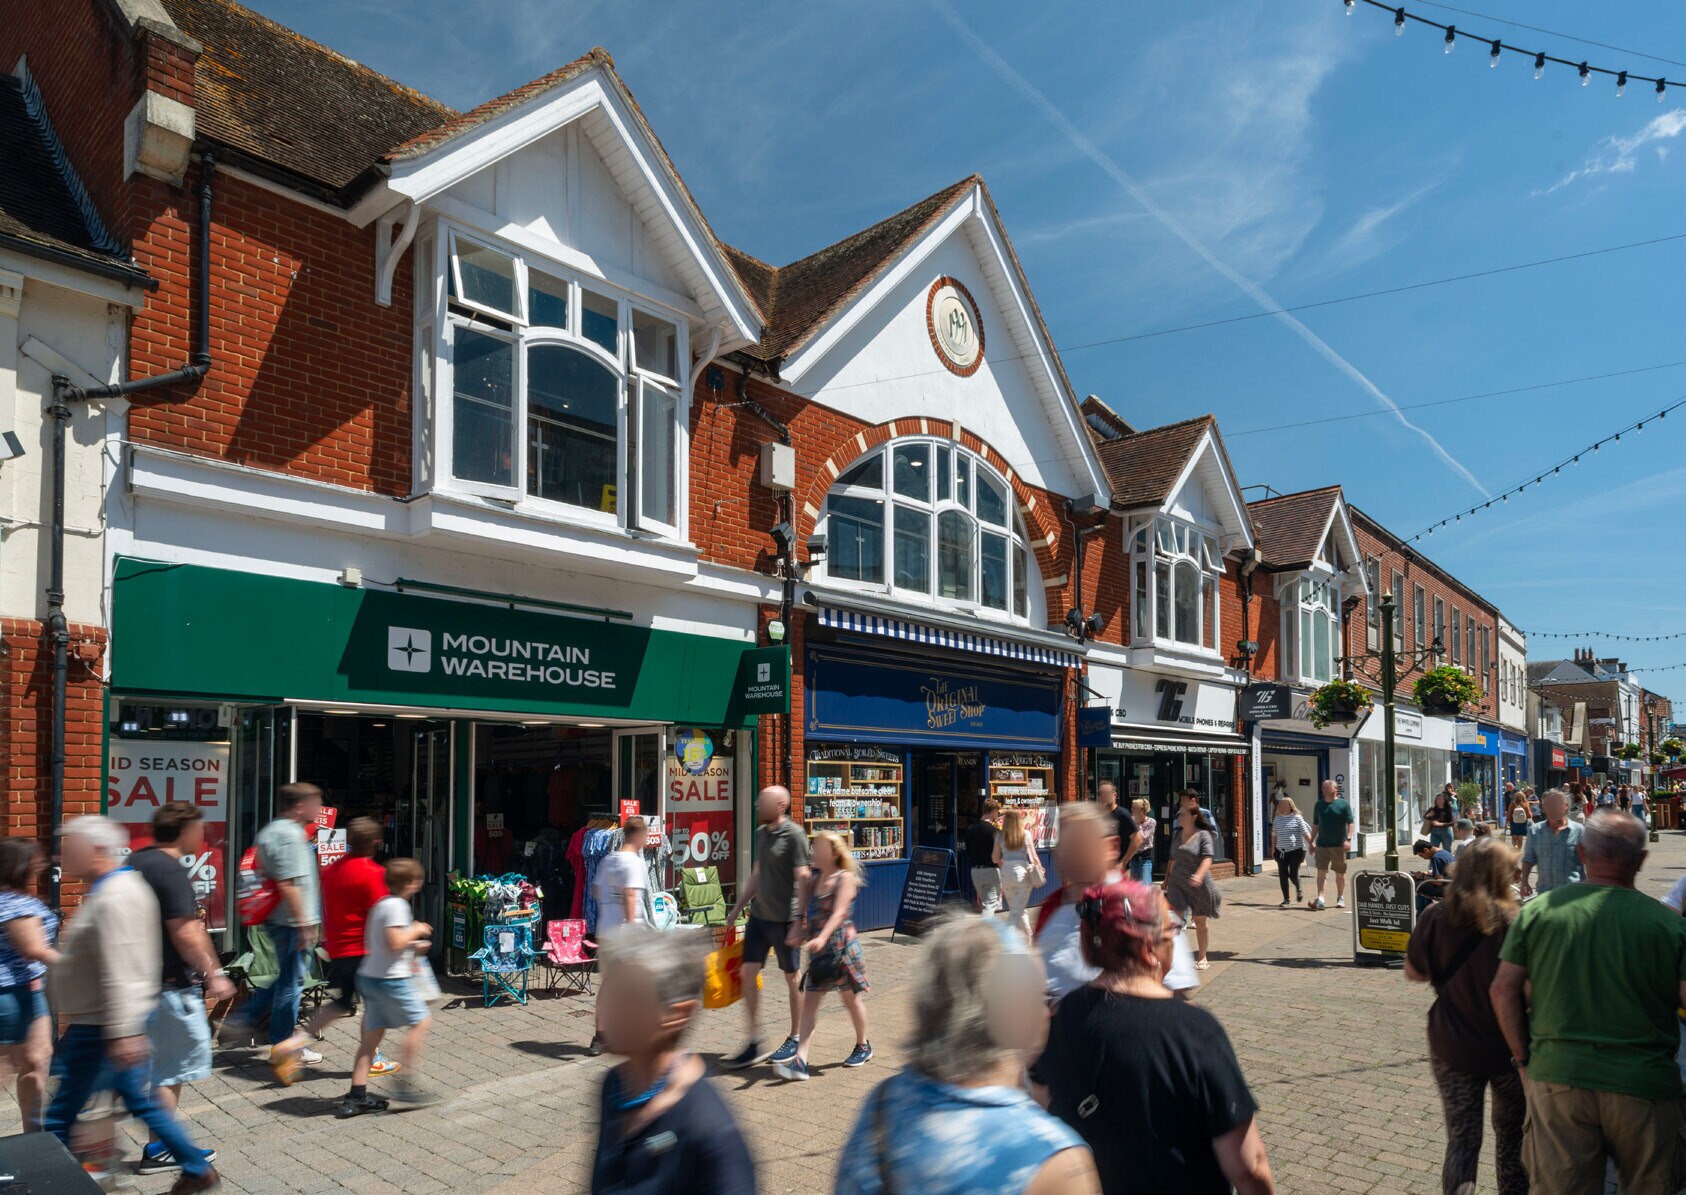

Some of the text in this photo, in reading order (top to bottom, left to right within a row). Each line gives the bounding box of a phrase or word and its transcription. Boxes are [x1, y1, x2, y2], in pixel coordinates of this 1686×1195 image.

[443, 632, 590, 664] MOUNTAIN
[440, 656, 616, 689] WAREHOUSE
[747, 684, 780, 693] MOUNTAIN
[745, 690, 784, 699] WAREHOUSE
[1179, 716, 1195, 725] MOBILE
[1196, 718, 1213, 727] PHONES
[1218, 720, 1235, 729] REPAIRS
[140, 757, 219, 772] SEASON
[669, 767, 687, 776] MID
[670, 780, 729, 802] SALE
[320, 843, 346, 852] SALE
[711, 851, 730, 861] OFF
